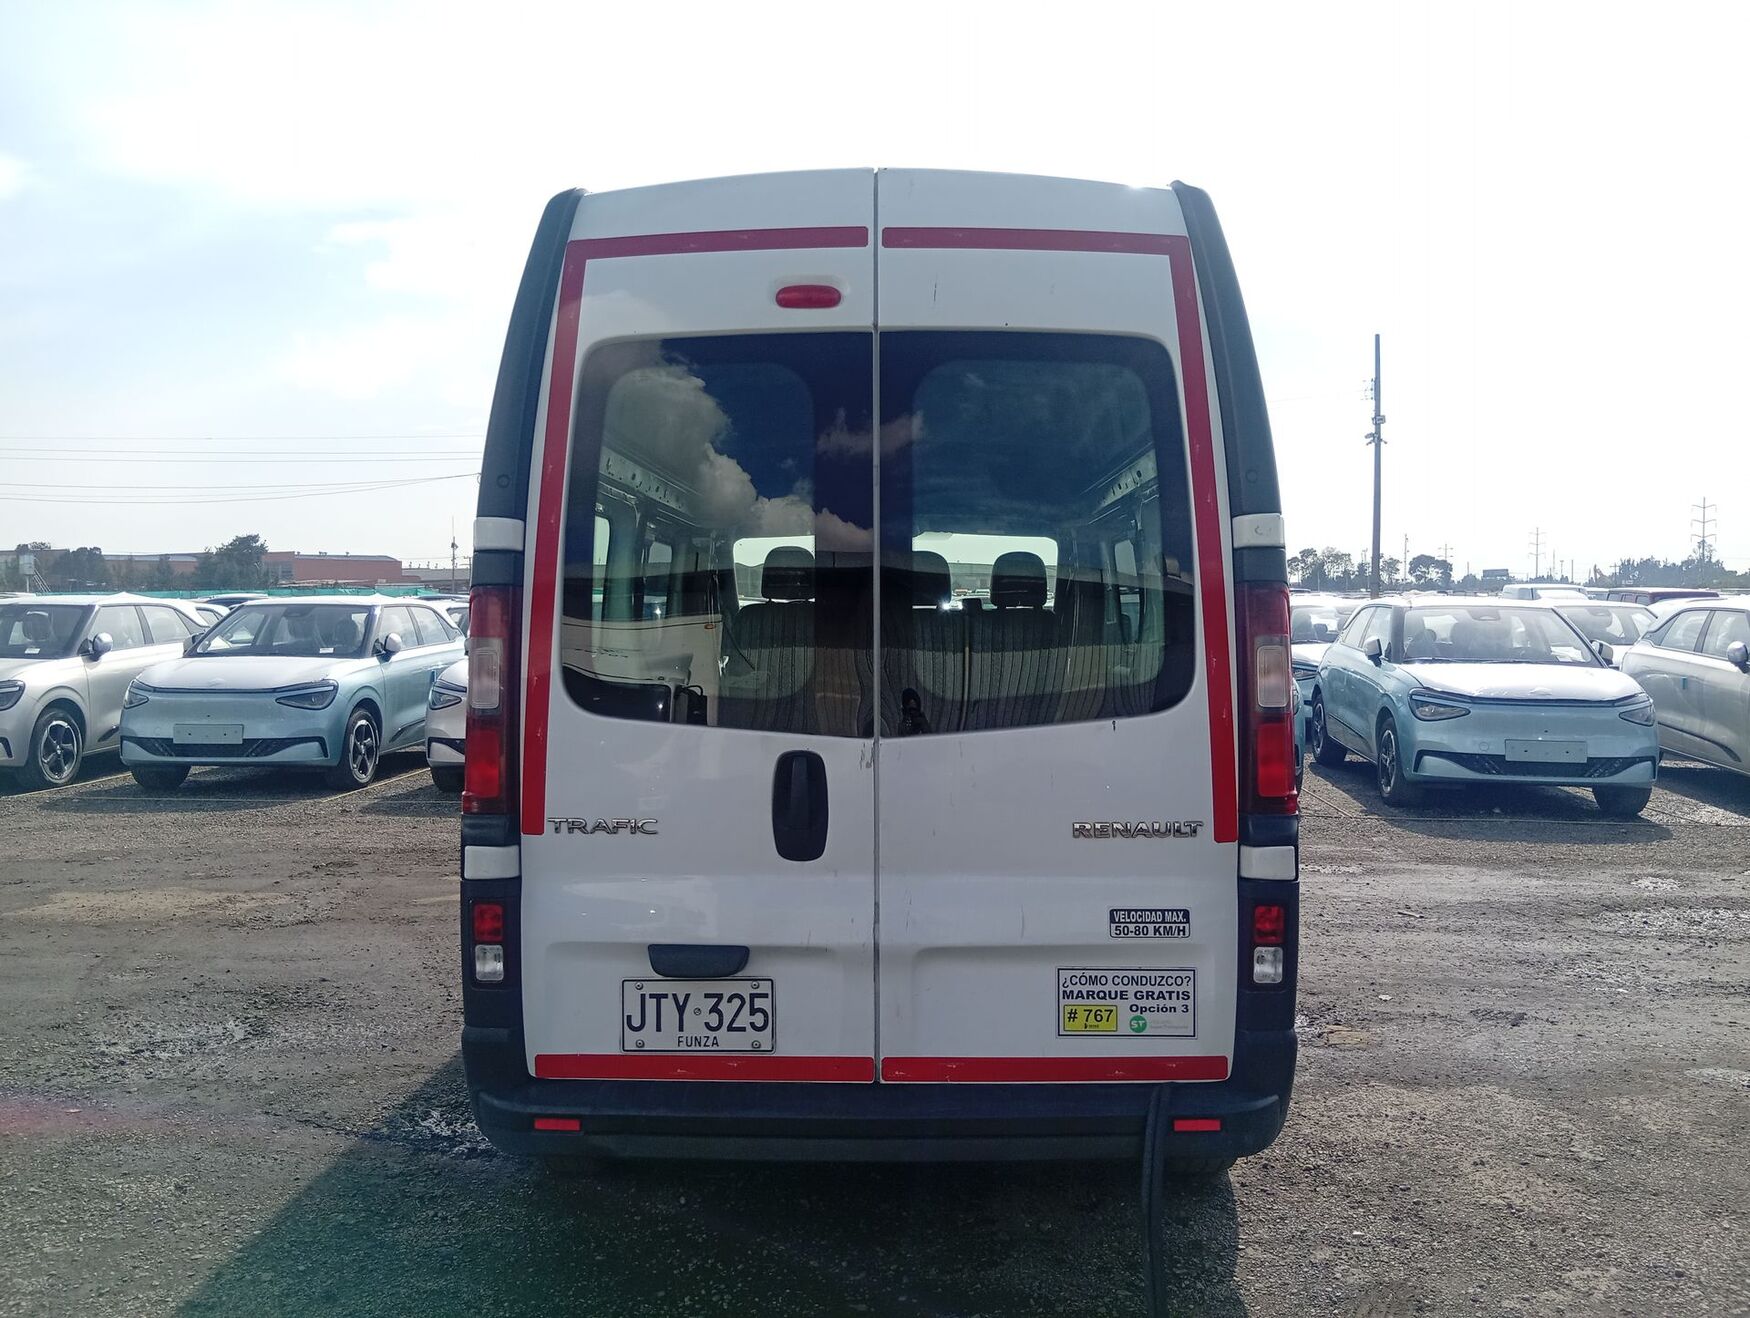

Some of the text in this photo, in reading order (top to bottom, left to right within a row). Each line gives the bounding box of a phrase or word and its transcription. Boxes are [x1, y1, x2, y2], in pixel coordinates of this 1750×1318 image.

[547, 817, 659, 835] TRAFIC
[1072, 821, 1204, 839] RENAULT
[1113, 911, 1187, 923] VELOCIDAD MAX.
[1114, 925, 1186, 936] 50-80 KM/H
[1062, 972, 1192, 988] ¿CÓMO CONDUZCO?
[1062, 990, 1191, 1001] MARQUE GRATIS
[626, 992, 770, 1033] JTY 325
[1083, 1008, 1114, 1023] 767
[1129, 1003, 1189, 1015] Opción 3
[1130, 1020, 1146, 1029] ST
[677, 1035, 720, 1048] FUNZA
